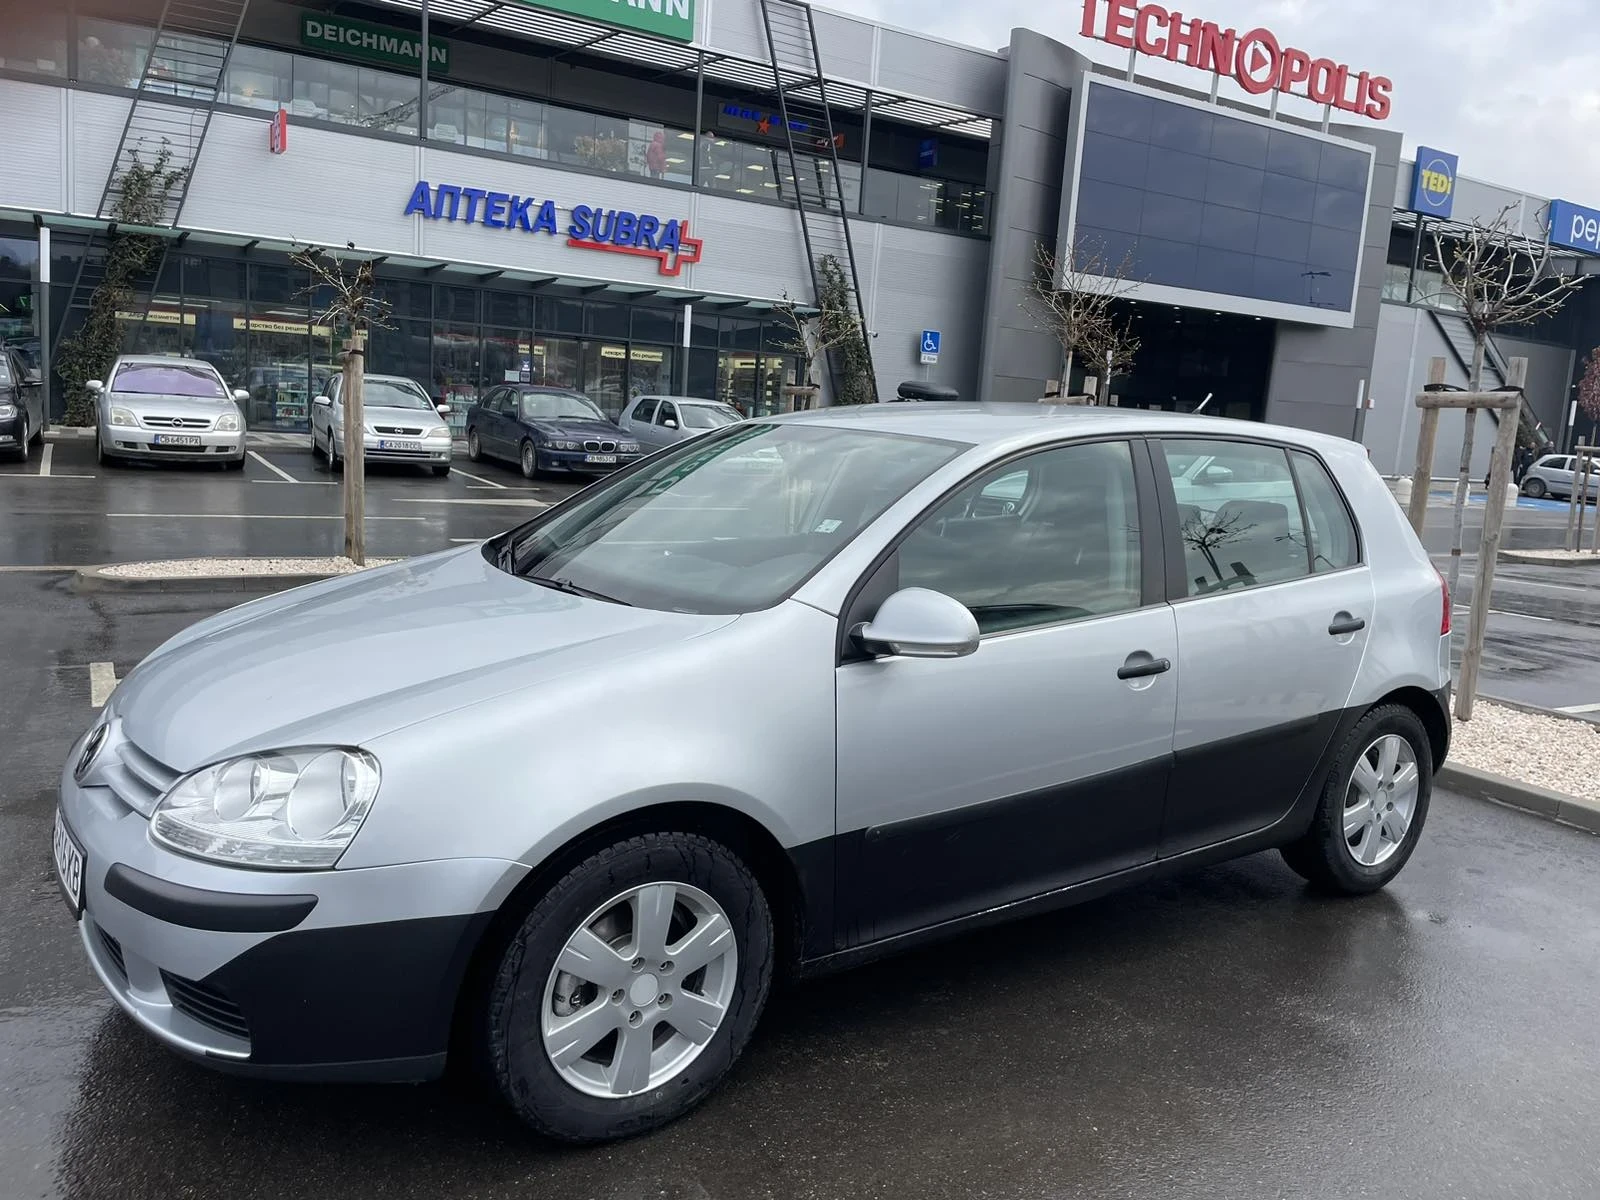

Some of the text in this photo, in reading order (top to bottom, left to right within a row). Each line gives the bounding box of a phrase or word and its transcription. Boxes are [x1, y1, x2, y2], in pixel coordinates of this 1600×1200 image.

[1080, 0, 1392, 119] TECHNOPOLIS
[404, 180, 681, 253] АПТЕКА SUBRA
[1422, 169, 1452, 195] TEDi
